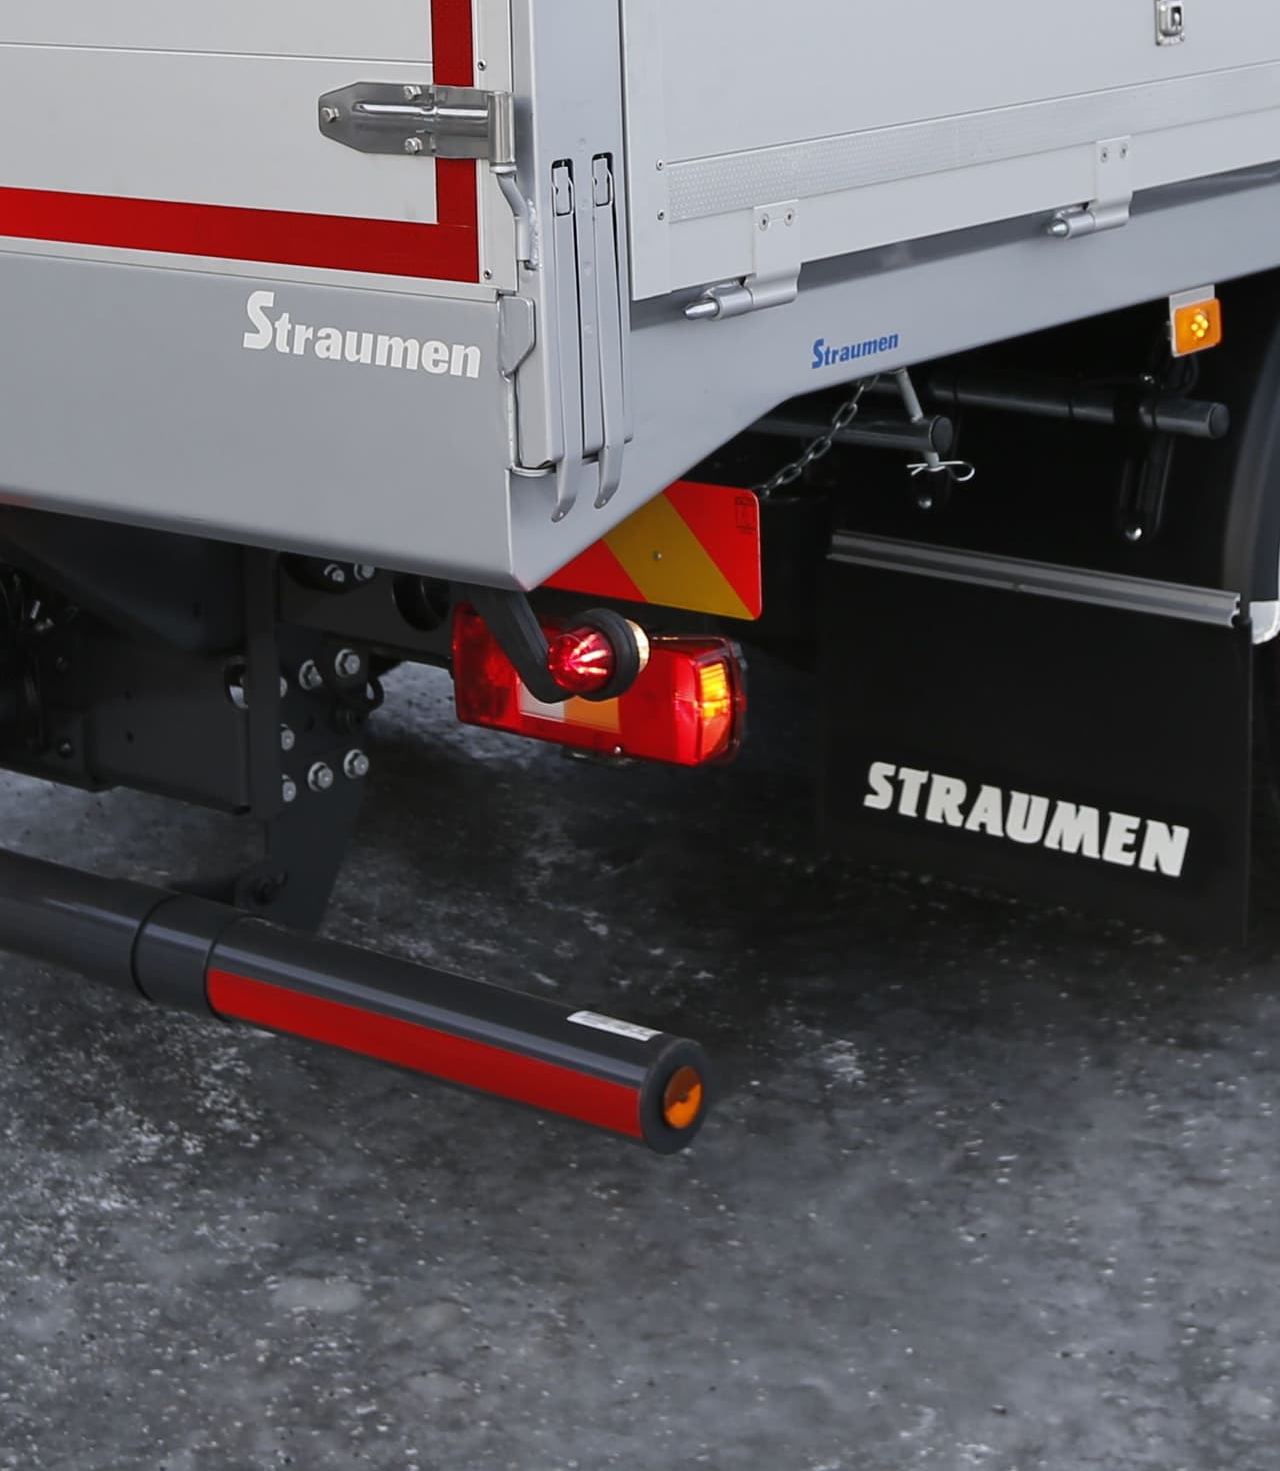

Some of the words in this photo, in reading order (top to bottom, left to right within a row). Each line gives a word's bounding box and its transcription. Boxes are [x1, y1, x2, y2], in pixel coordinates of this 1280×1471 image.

[243, 290, 482, 378] Straumen
[812, 333, 899, 369] Straumen
[864, 761, 1190, 878] STRAUMEN
